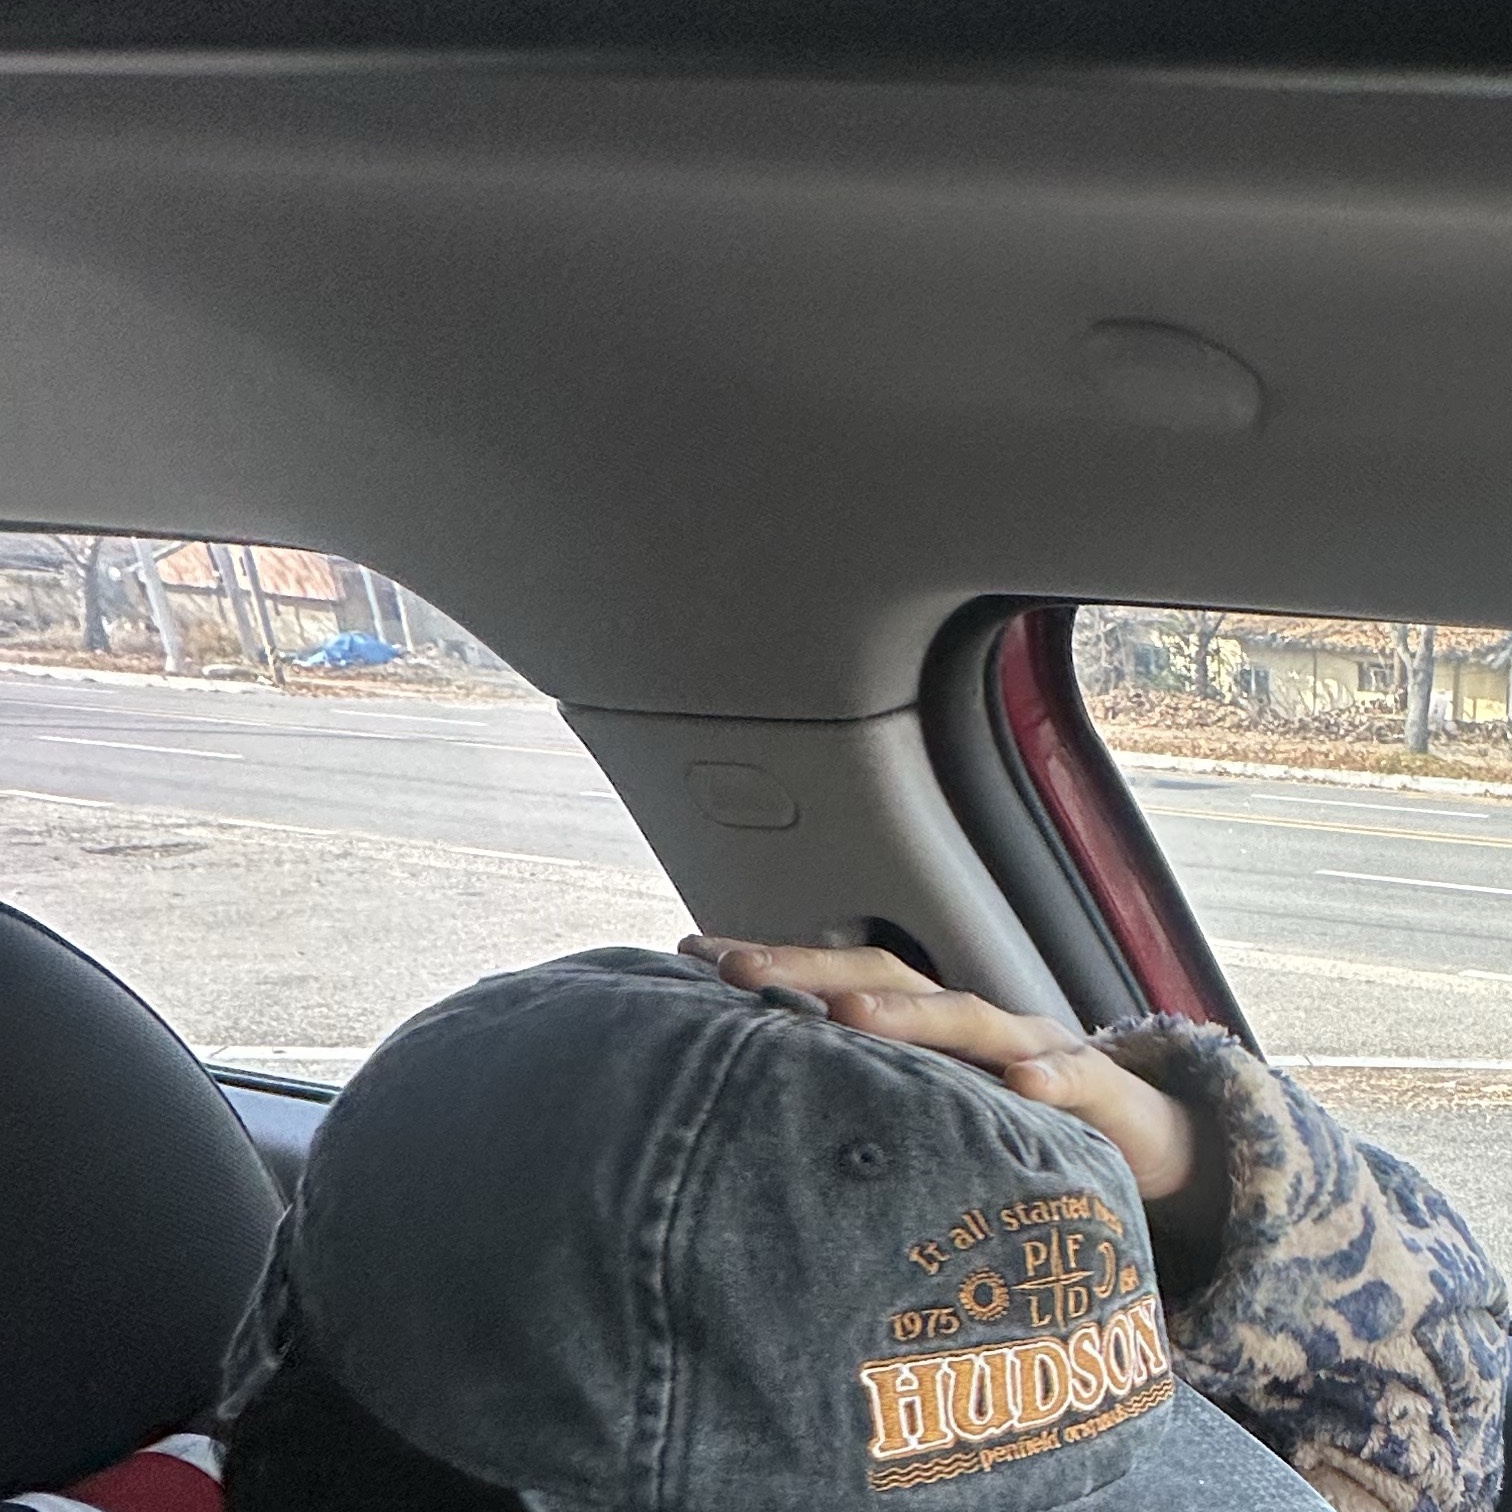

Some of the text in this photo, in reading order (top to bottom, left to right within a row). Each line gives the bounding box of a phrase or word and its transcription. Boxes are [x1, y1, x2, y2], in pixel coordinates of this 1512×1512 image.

[949, 1209, 994, 1251] all
[890, 1308, 961, 1341] 1975
[860, 1296, 1170, 1460] HUDSON
